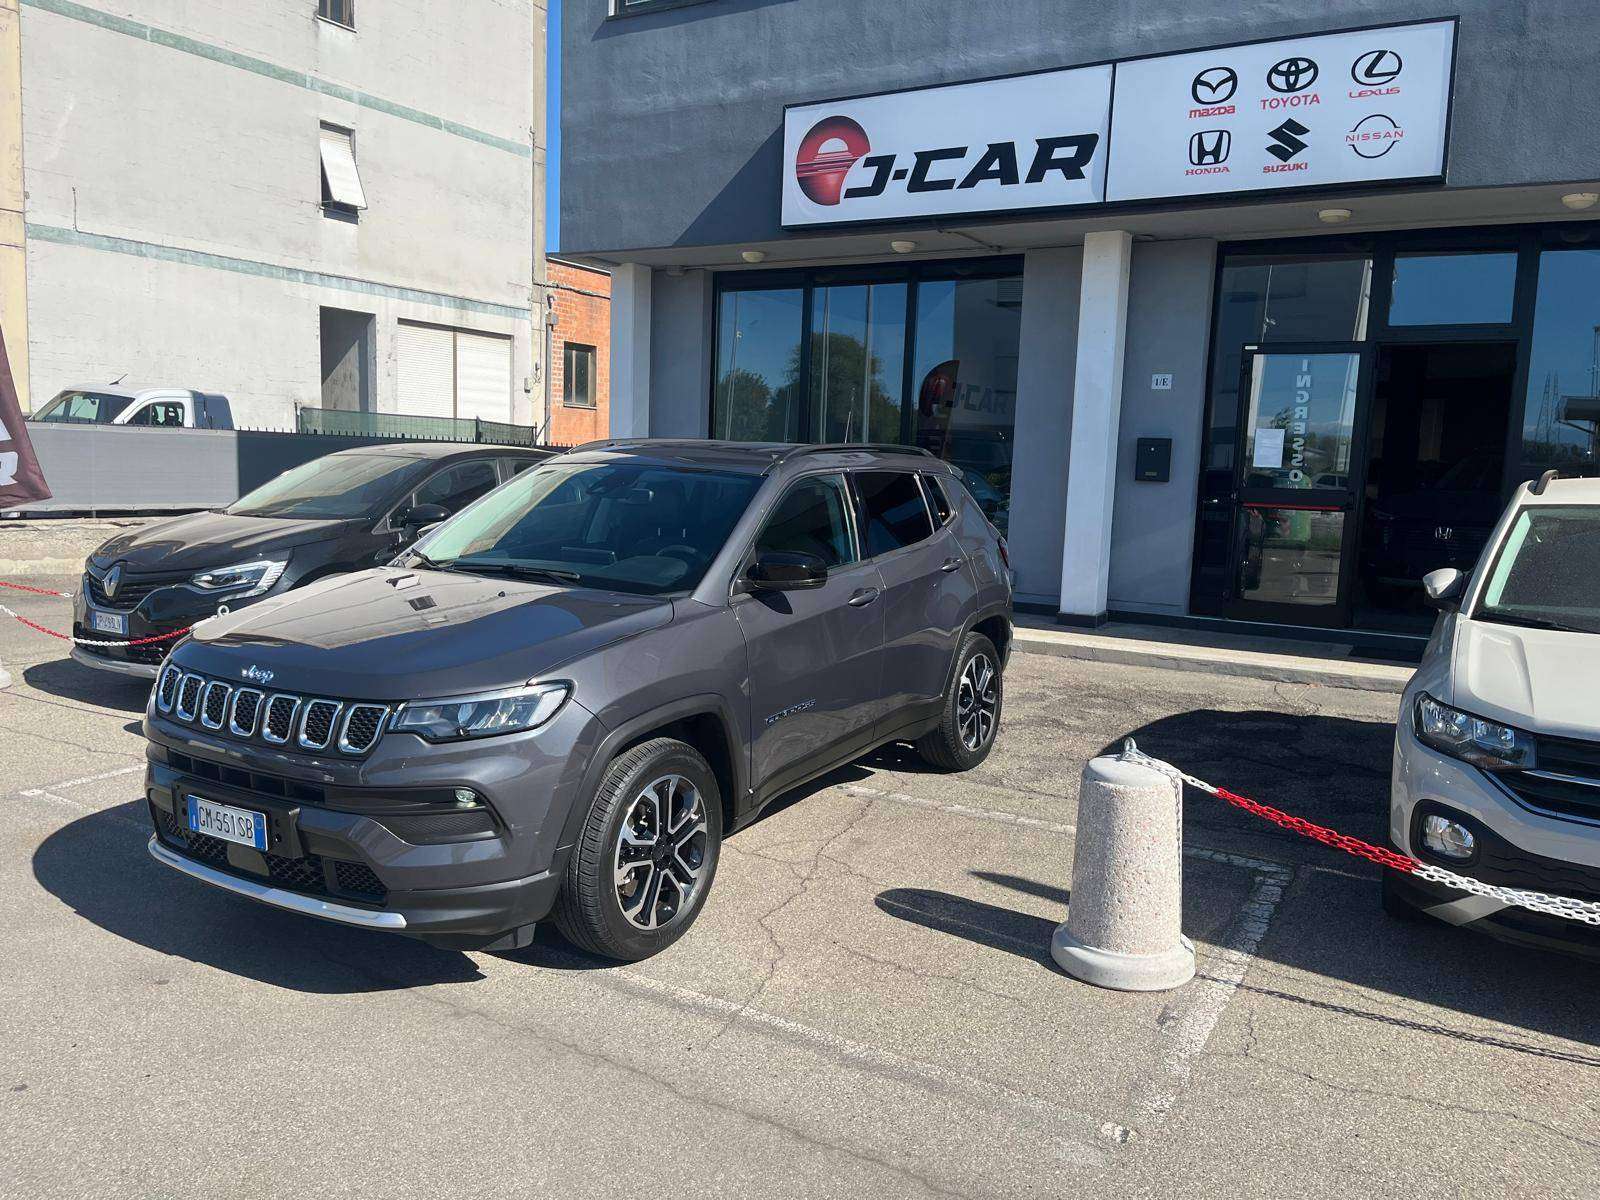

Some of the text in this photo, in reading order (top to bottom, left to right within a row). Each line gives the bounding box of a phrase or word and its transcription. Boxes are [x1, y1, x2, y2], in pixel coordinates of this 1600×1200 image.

[1348, 87, 1401, 99] LEXUS
[1261, 94, 1320, 110] TOYOTA
[1345, 130, 1404, 142] NISSAN
[843, 133, 1099, 199] J-CAR
[1184, 166, 1231, 176] HONDA
[1263, 162, 1308, 174] SUZUKI
